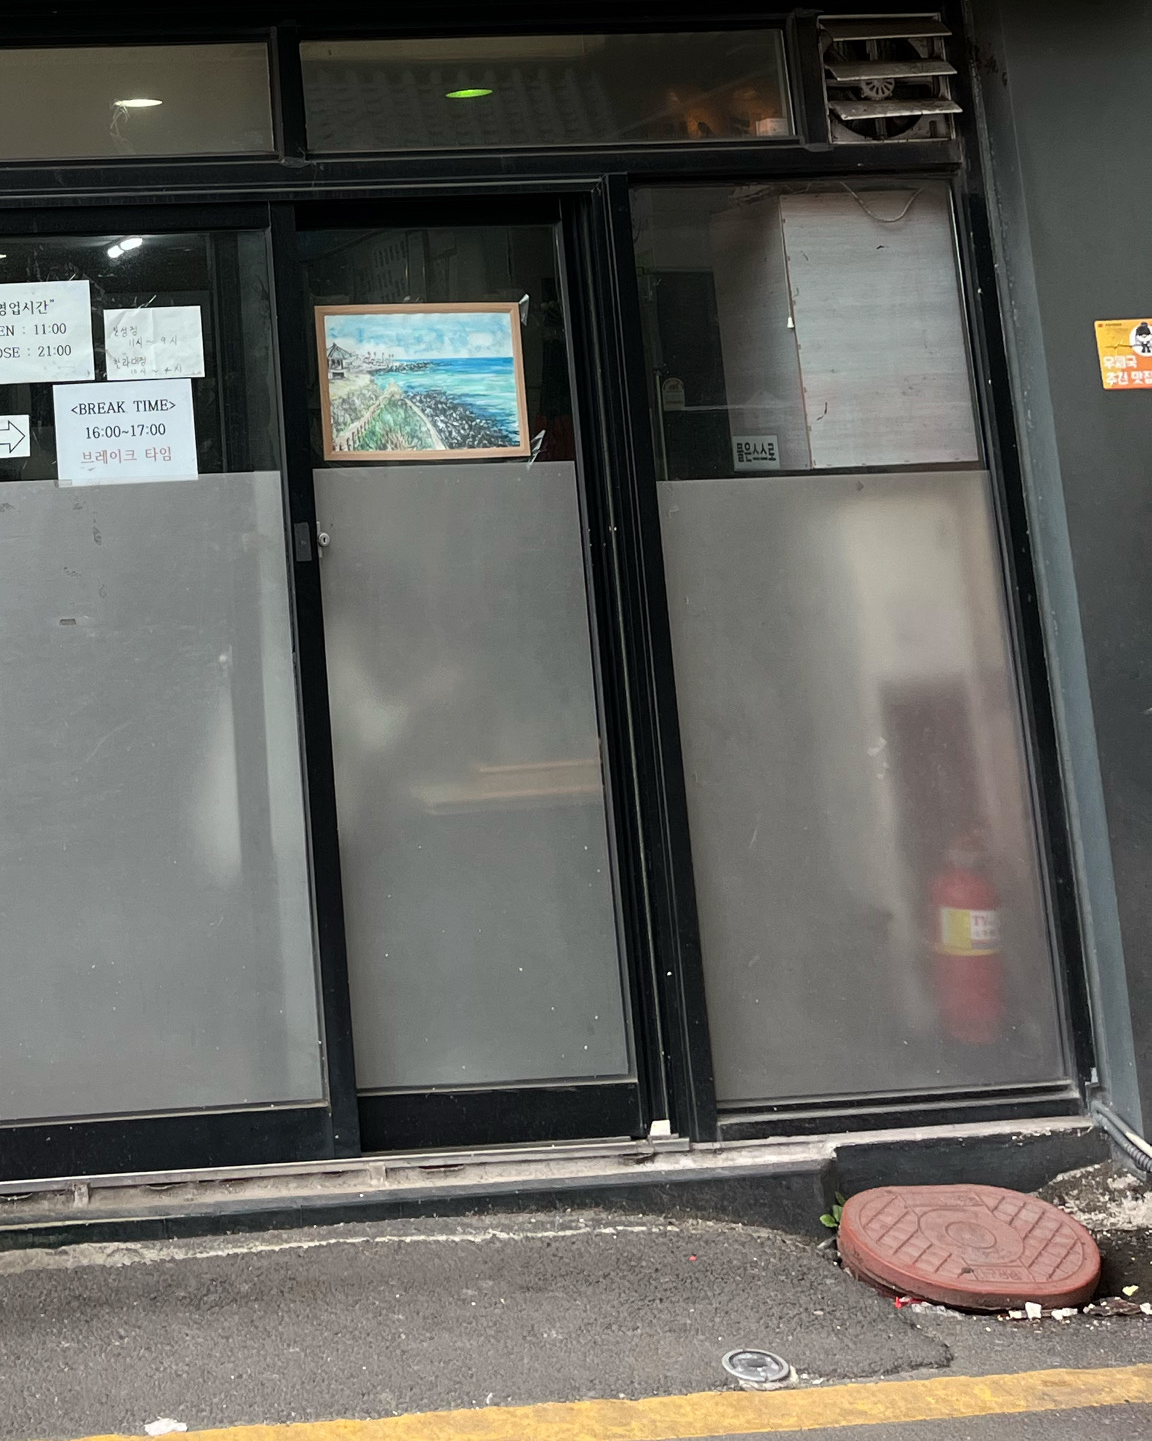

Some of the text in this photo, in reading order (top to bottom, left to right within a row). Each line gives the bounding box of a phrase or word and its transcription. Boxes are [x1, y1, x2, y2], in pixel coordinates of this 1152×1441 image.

[34, 323, 67, 336] 11:00
[38, 345, 72, 358] 21:00
[86, 423, 166, 439] 16:00~17:00
[81, 446, 172, 464] 브레이크 타임
